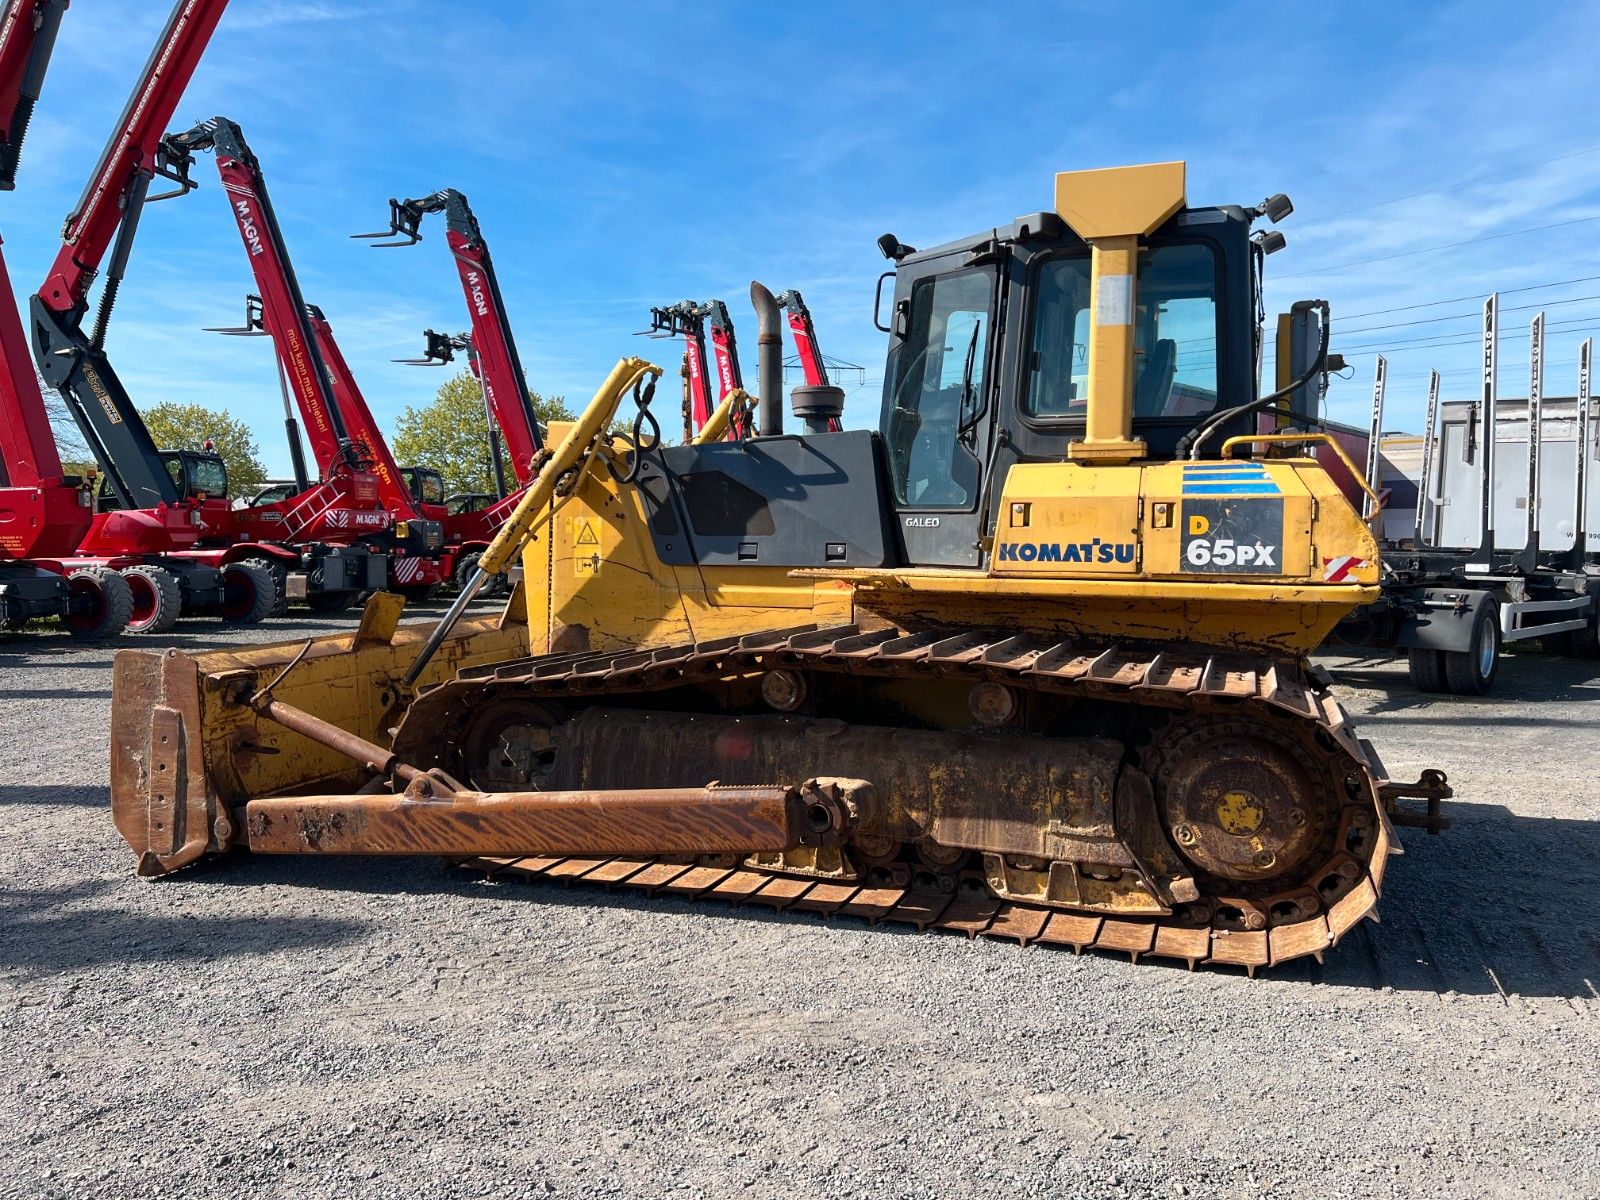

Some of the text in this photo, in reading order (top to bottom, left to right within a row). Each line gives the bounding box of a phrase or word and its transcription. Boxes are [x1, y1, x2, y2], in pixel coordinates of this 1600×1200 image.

[236, 200, 264, 256] MAGNI
[467, 271, 488, 316] MAGNI
[688, 347, 699, 379] MAGNI
[719, 355, 732, 392] MAGNI
[1484, 331, 1493, 384] OPTIPA
[287, 329, 300, 352] mich
[295, 352, 307, 376] kann
[303, 377, 314, 398] man
[310, 398, 328, 433] mieten!
[355, 514, 380, 525] MAGNI
[905, 517, 940, 527] GALEO
[1189, 515, 1210, 535] D
[999, 537, 1135, 564] KOMATSU
[1186, 539, 1276, 566] 65PX
